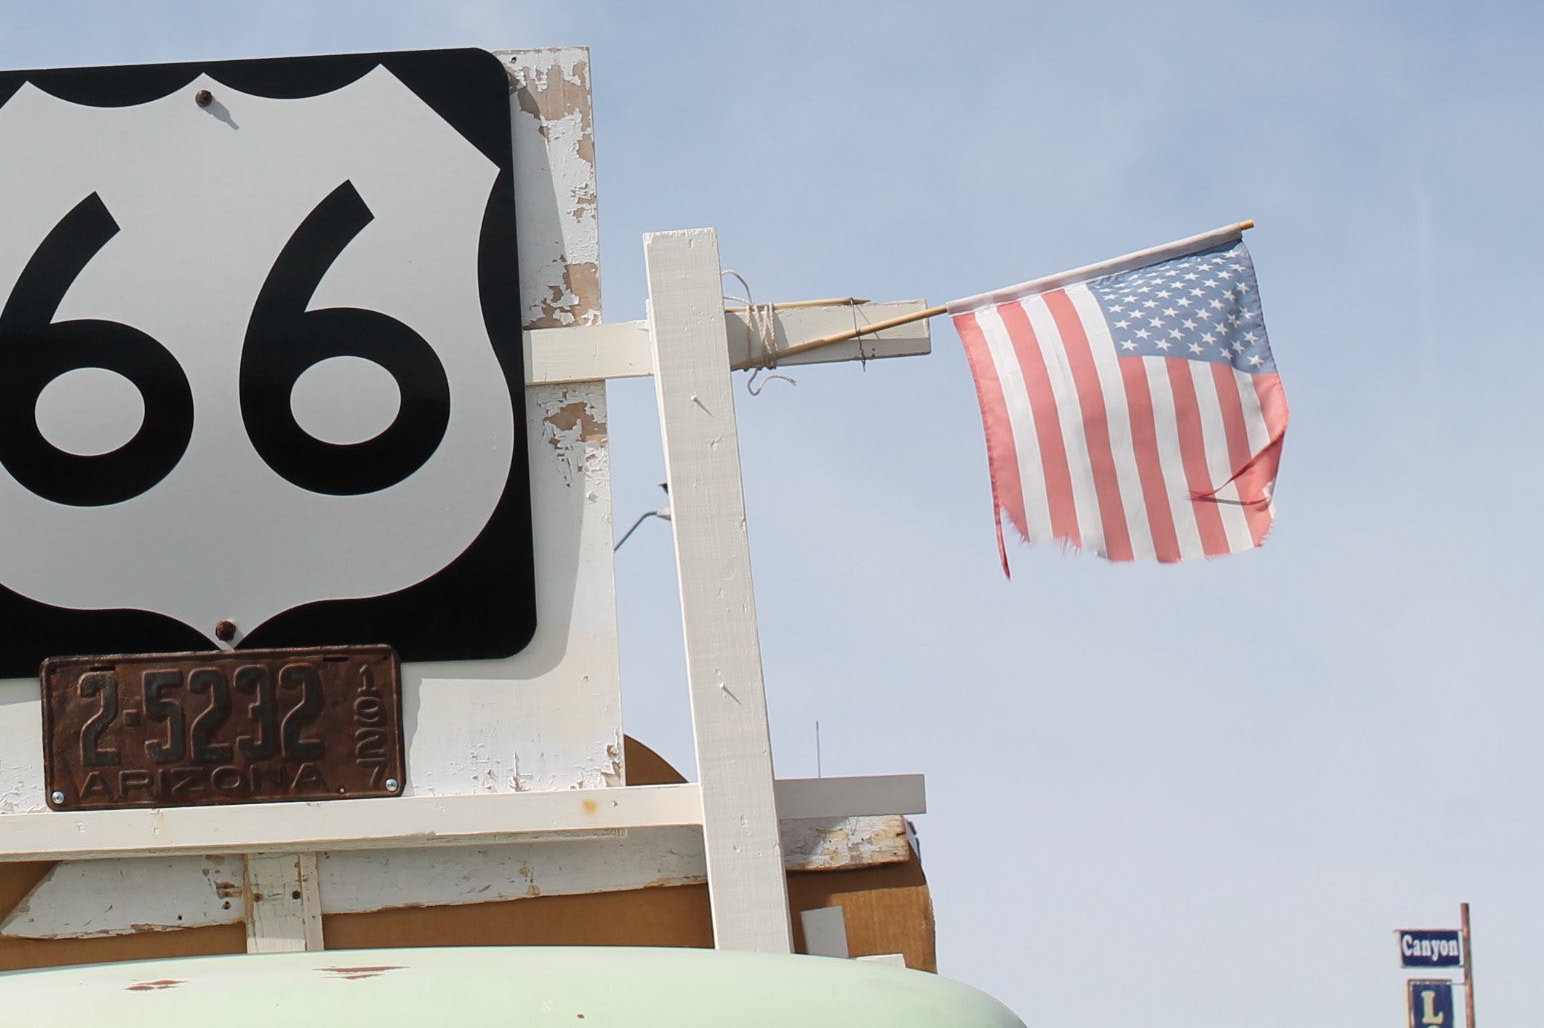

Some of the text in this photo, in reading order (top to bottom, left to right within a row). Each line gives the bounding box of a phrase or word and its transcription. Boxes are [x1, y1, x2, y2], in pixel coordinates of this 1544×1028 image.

[79, 762, 327, 799] ARIZONA
[1402, 934, 1459, 961] Canyon
[1420, 990, 1444, 1028] L
